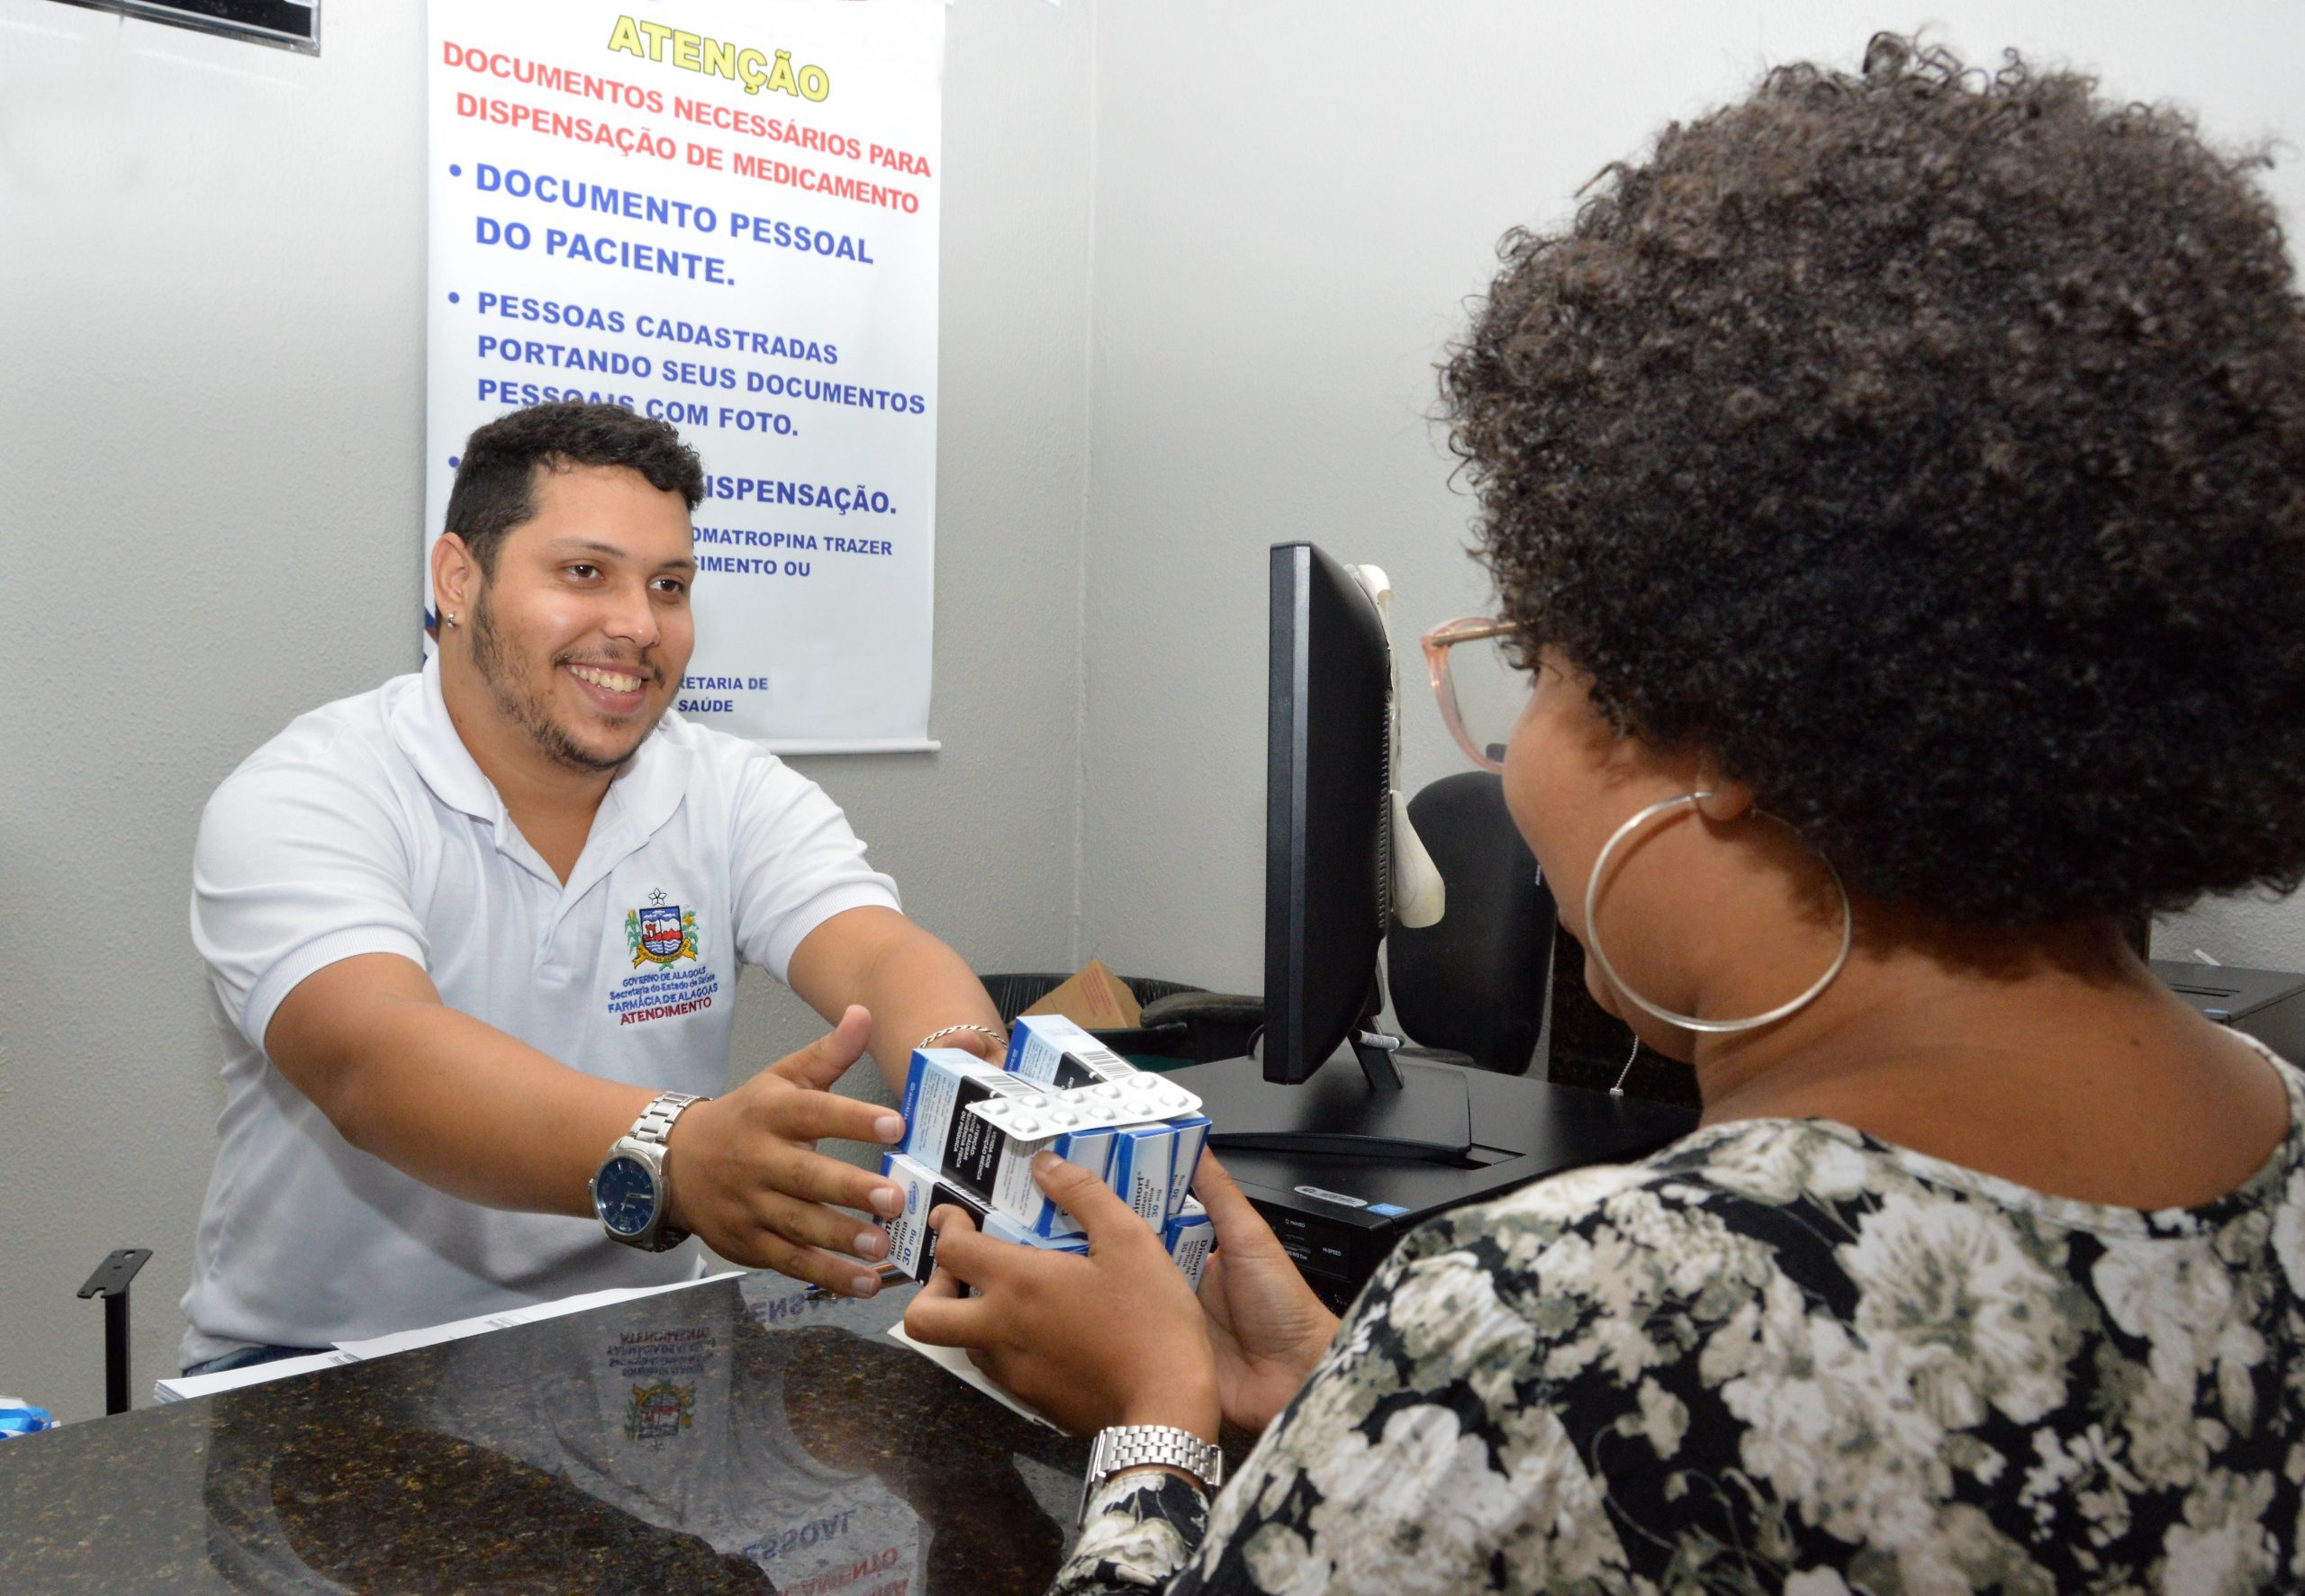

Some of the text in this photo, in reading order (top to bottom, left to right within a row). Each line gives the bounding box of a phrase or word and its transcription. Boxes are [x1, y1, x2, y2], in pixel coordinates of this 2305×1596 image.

[608, 15, 830, 103] ATENÇÃO
[442, 41, 932, 177] DOCUMENTOS NECESSÁRIOS PARA
[456, 91, 919, 215] DISPENSAÇÃO DE MEDICAMENTO
[475, 162, 874, 266] DOCUMENTO PESSOAL
[475, 216, 736, 286] DO PACIENTE.
[478, 291, 838, 365] PESSOAS CADASTRADAS
[478, 335, 926, 415] PORTANDO SEUS DOCUMENTOS
[646, 398, 709, 427] COM
[719, 407, 799, 437] FOTO.
[706, 474, 897, 516] ISPENSAÇÃO.
[692, 526, 893, 555] OMATROPINA TRAZER
[784, 560, 810, 576] OU
[748, 677, 769, 690] DE
[678, 697, 734, 713] SAÚDE
[610, 986, 650, 1000] Secretaria
[622, 966, 707, 987] GOVERNO DE ALAGOAS
[608, 982, 719, 1014] FARMÁCIA DE ALAGOAS
[619, 996, 712, 1025] ATENDIMENTO
[890, 1221, 900, 1256] sulfato
[896, 1221, 908, 1260] morfina
[902, 1229, 917, 1266] 30 mg
